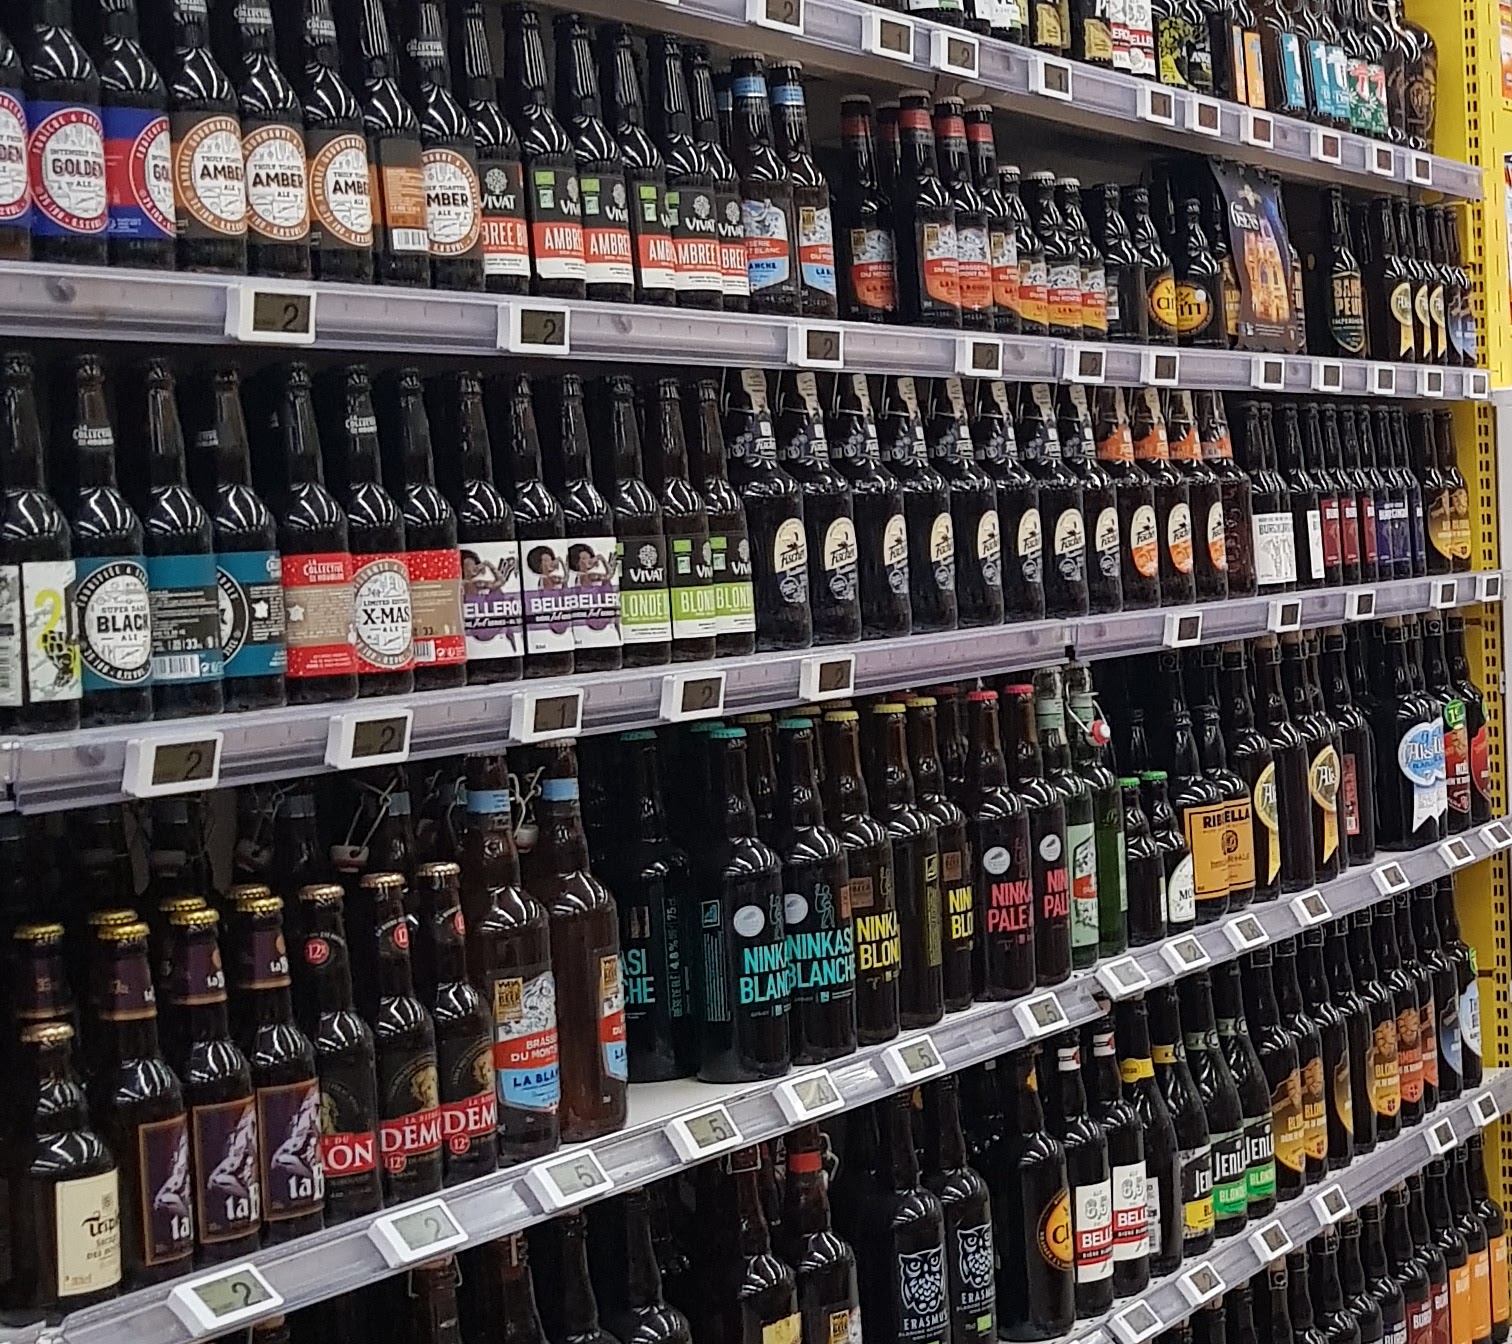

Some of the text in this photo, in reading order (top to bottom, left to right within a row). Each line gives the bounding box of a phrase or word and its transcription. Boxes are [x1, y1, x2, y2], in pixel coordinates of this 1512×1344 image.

[783, 1, 794, 23] 2
[52, 158, 104, 179] GOLDEN
[200, 164, 244, 182] AMBE
[252, 172, 304, 188] AMBER
[332, 179, 369, 196] AMBE
[426, 192, 469, 208] MBER
[480, 193, 516, 209] VIVAT
[481, 222, 515, 245] BREE
[685, 217, 716, 232] VIVAT
[718, 222, 744, 237] VIVAT
[545, 228, 584, 251] AMBRE
[283, 303, 298, 332] 2
[543, 319, 556, 343] 2
[823, 340, 833, 357] 2
[629, 567, 665, 583] VIVAT
[464, 600, 521, 617] ELLERO
[531, 596, 571, 613] BELLE
[569, 592, 621, 608] BELLER
[621, 590, 665, 618] LONDE
[95, 614, 150, 633] BLACK
[363, 607, 410, 626] X-MAS
[121, 634, 138, 642] ALE
[383, 625, 399, 633] ALE
[701, 685, 712, 707] 2
[560, 704, 567, 728] 1
[380, 725, 396, 751] 2
[186, 752, 203, 781] 2
[988, 907, 1028, 933] PALE
[786, 926, 852, 961] NINKASI
[510, 1052, 528, 1062] DU
[918, 1048, 932, 1068] 5
[513, 1075, 533, 1088] LA
[443, 1102, 497, 1134] DEM
[711, 1118, 727, 1138] 5
[381, 1116, 441, 1152] DEM
[575, 1164, 596, 1189] 5
[422, 1215, 444, 1243] 2
[1082, 1225, 1112, 1247] BELLE
[232, 1281, 251, 1306] 2
[903, 1310, 949, 1331] ERASMUS
